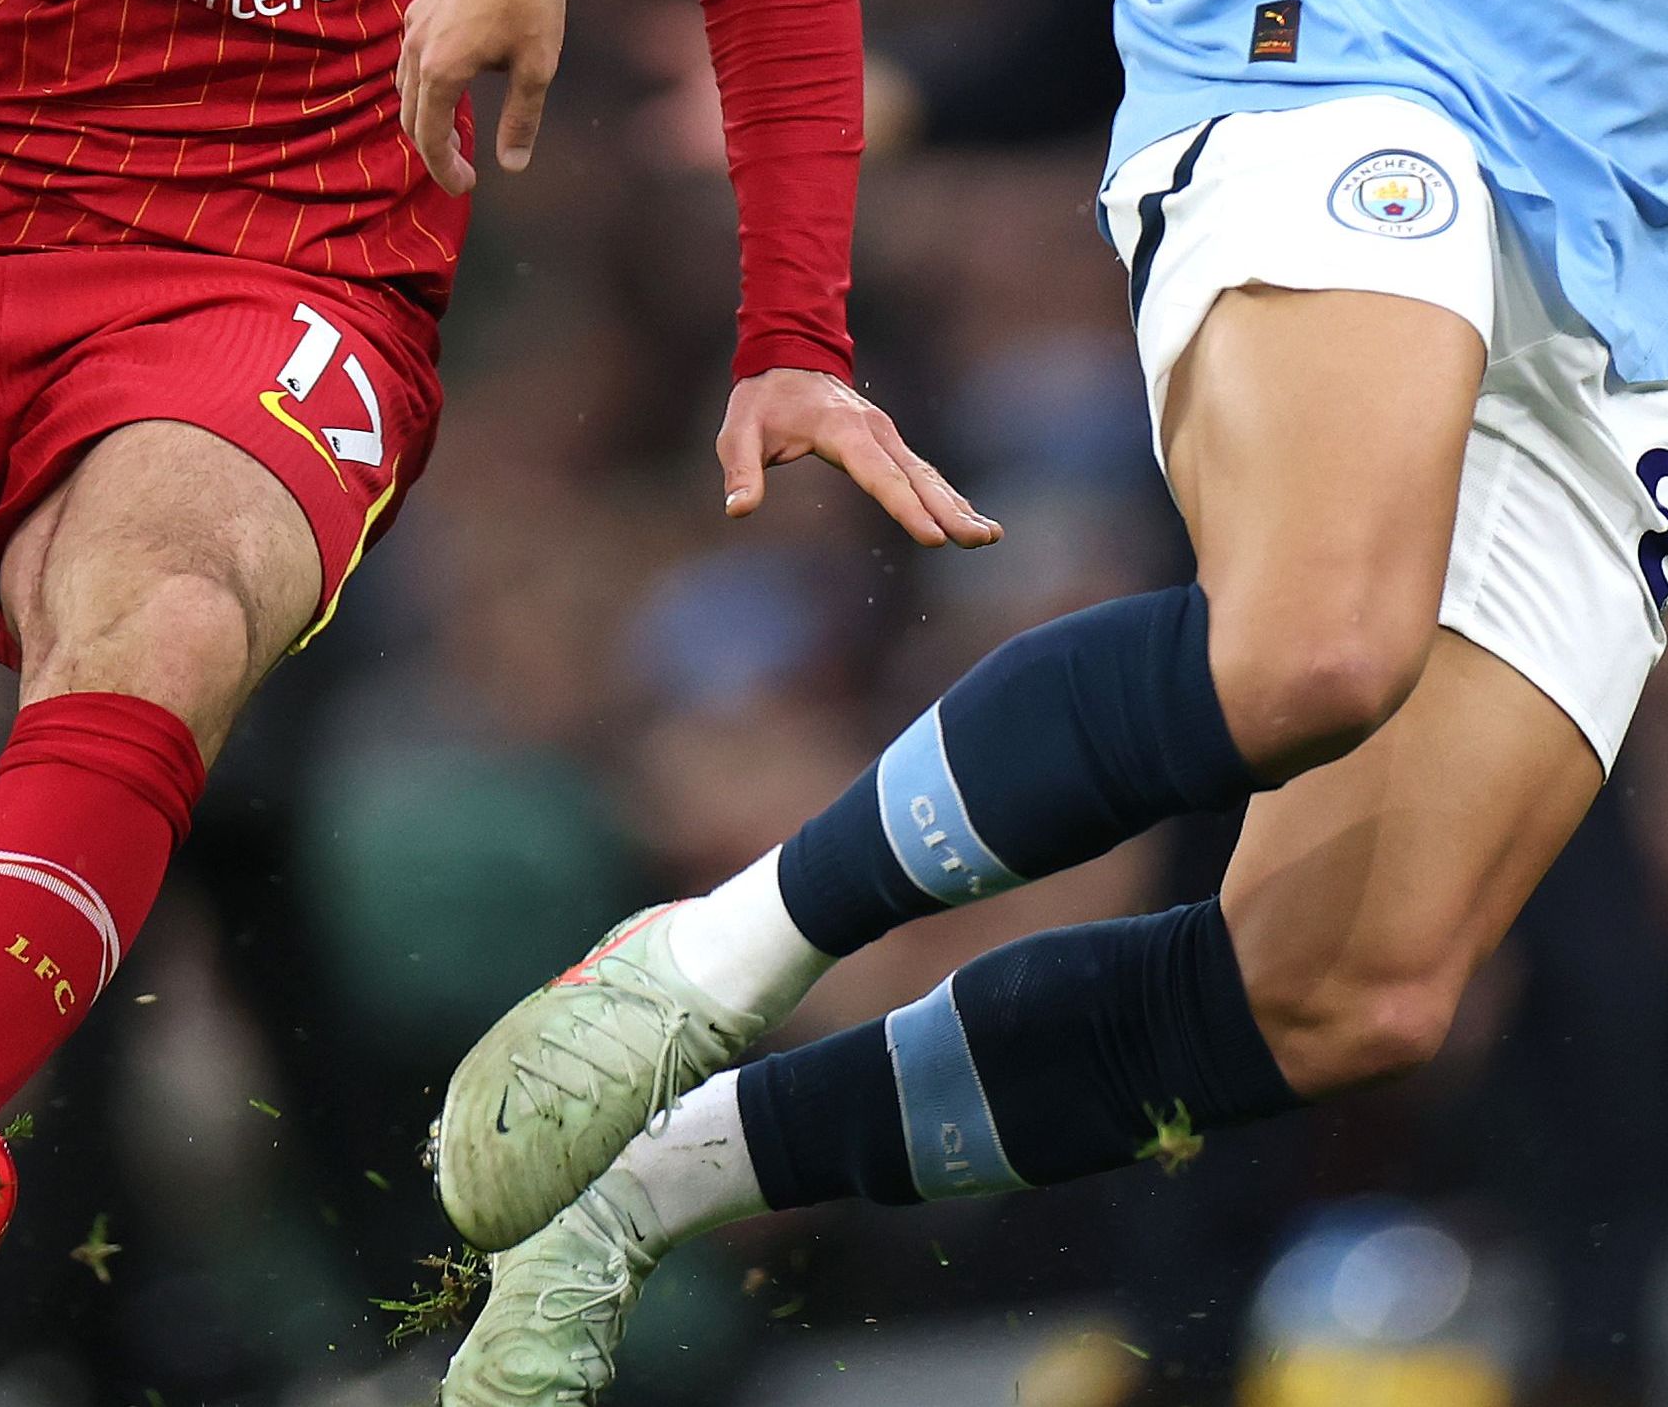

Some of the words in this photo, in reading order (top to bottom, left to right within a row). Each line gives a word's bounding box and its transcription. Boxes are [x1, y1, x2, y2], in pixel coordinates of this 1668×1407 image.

[1343, 159, 1442, 191] MANCHESTER
[1378, 224, 1413, 233] CITY
[275, 300, 384, 467] 17
[5, 933, 76, 1016] LFC
